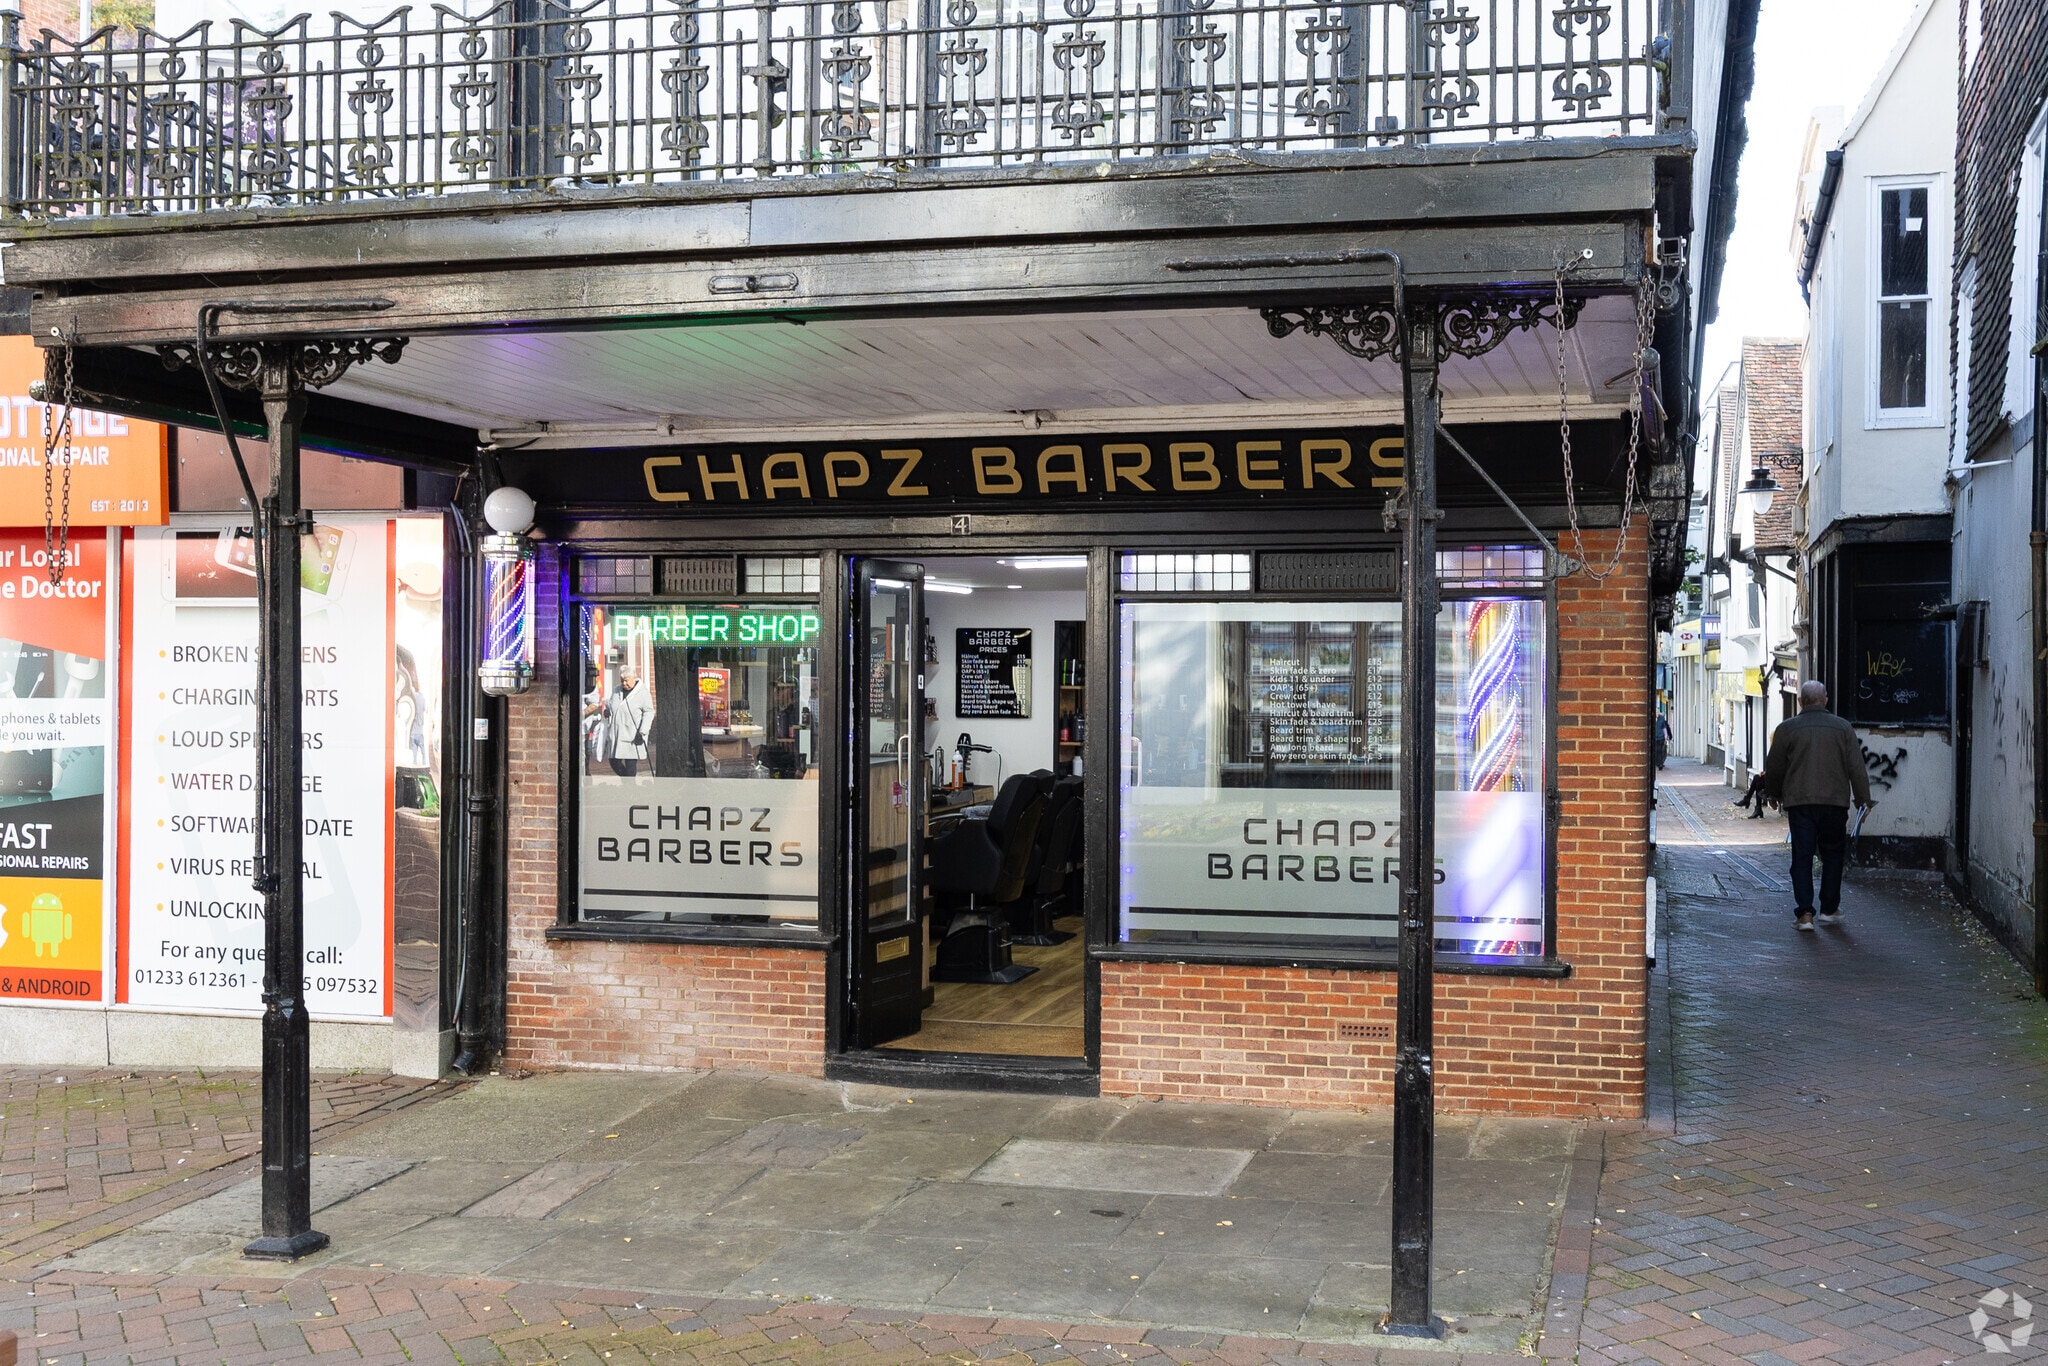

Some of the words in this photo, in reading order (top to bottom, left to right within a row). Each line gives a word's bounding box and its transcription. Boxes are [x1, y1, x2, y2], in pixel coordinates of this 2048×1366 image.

[48, 446, 109, 466] REPAIR
[644, 448, 929, 502] CHAPZ
[971, 437, 1404, 494] BARBERS
[90, 500, 110, 512] EST
[119, 500, 148, 512] 2013
[954, 517, 968, 534] 4
[20, 543, 80, 567] Local
[22, 575, 101, 598] Doctor
[614, 614, 730, 642] BARBER
[740, 615, 820, 642] SHOP
[173, 646, 248, 663] BROKEN
[172, 688, 257, 706] CHARGIN
[2, 712, 45, 727] phones
[48, 712, 56, 724] &
[60, 712, 100, 725] tablets
[12, 732, 34, 744] you
[37, 730, 65, 741] wait.
[172, 730, 224, 748] LOUD
[172, 773, 234, 790] WATER
[629, 805, 771, 832] CHAPZ
[1244, 818, 1400, 847] CHAPZ
[598, 838, 803, 866] BARBERS
[42, 856, 89, 870] REPAIRS
[170, 858, 224, 876] VIRUS
[170, 900, 265, 920] UNLOCKIN
[161, 940, 190, 958] For
[194, 945, 227, 964] any
[306, 946, 343, 964] call:
[2, 978, 12, 993] &
[16, 978, 91, 996] ANDROID
[135, 969, 183, 986] 01233
[188, 971, 246, 988] 612361
[316, 977, 377, 994] 097532
